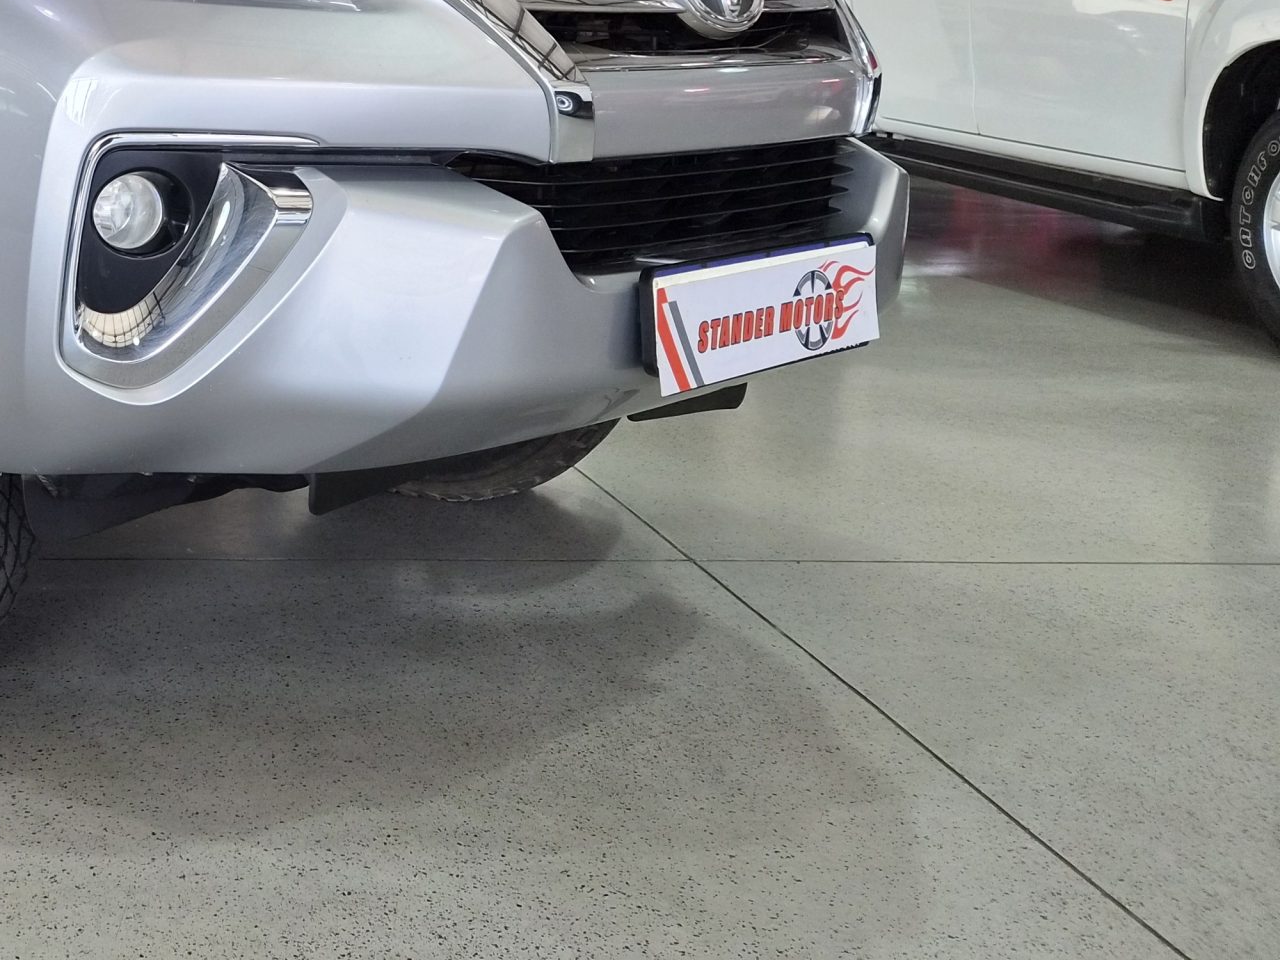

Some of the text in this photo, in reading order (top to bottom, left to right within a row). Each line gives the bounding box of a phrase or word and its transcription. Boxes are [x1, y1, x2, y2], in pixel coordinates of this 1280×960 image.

[1239, 138, 1280, 270] CATCHFO
[697, 289, 845, 354] STANDER MOTORS
